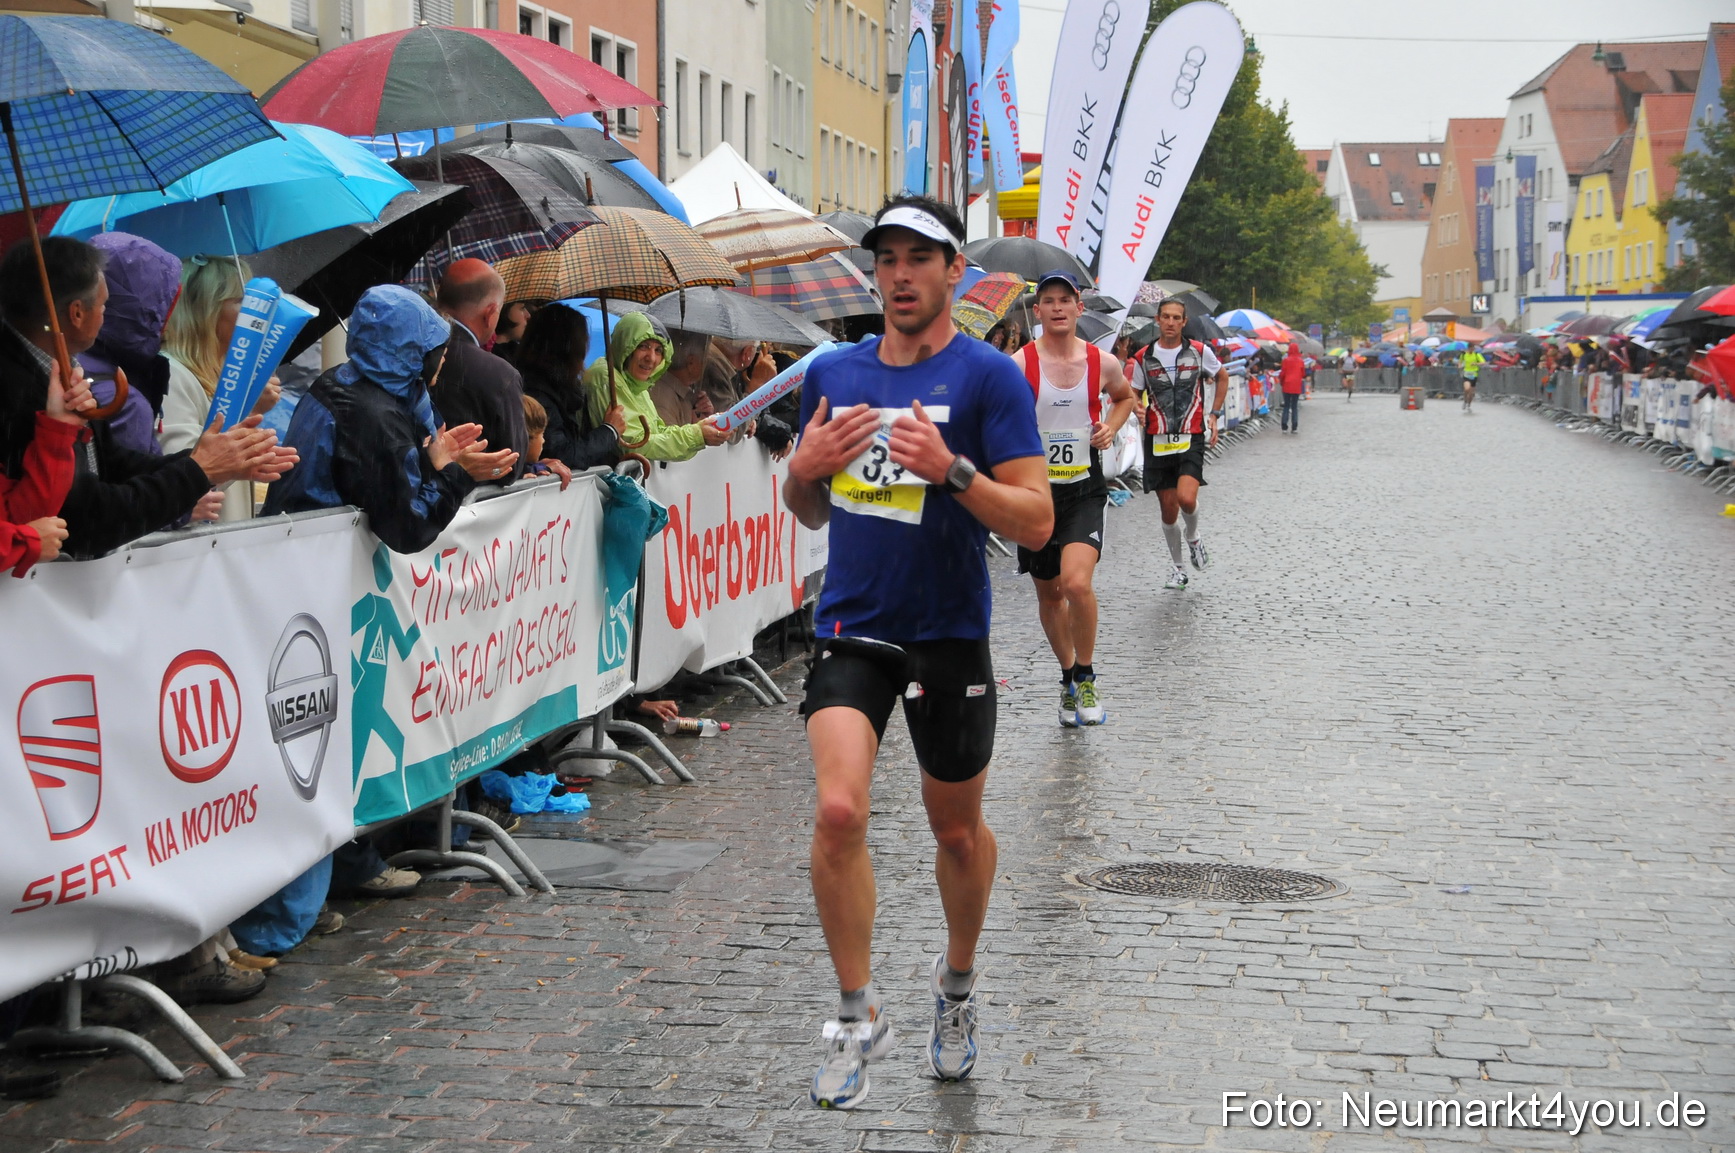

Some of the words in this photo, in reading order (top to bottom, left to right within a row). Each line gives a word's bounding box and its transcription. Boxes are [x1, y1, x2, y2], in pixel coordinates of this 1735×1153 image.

[1056, 167, 1082, 248] Audi
[1072, 91, 1098, 162] BKK
[1121, 194, 1155, 263] Audi
[1144, 128, 1177, 188] BKK
[733, 404, 752, 421] TUI
[749, 371, 805, 410] ReiseCenter
[1049, 443, 1074, 465] 26
[460, 537, 501, 615] UNS
[662, 473, 785, 630] Oberbank
[509, 600, 578, 685] BESSER.
[169, 678, 231, 757] KIA
[271, 686, 330, 731] NISSAN
[144, 817, 180, 867] KIA
[181, 784, 259, 851] MOTORS
[10, 844, 132, 914] SEAT
